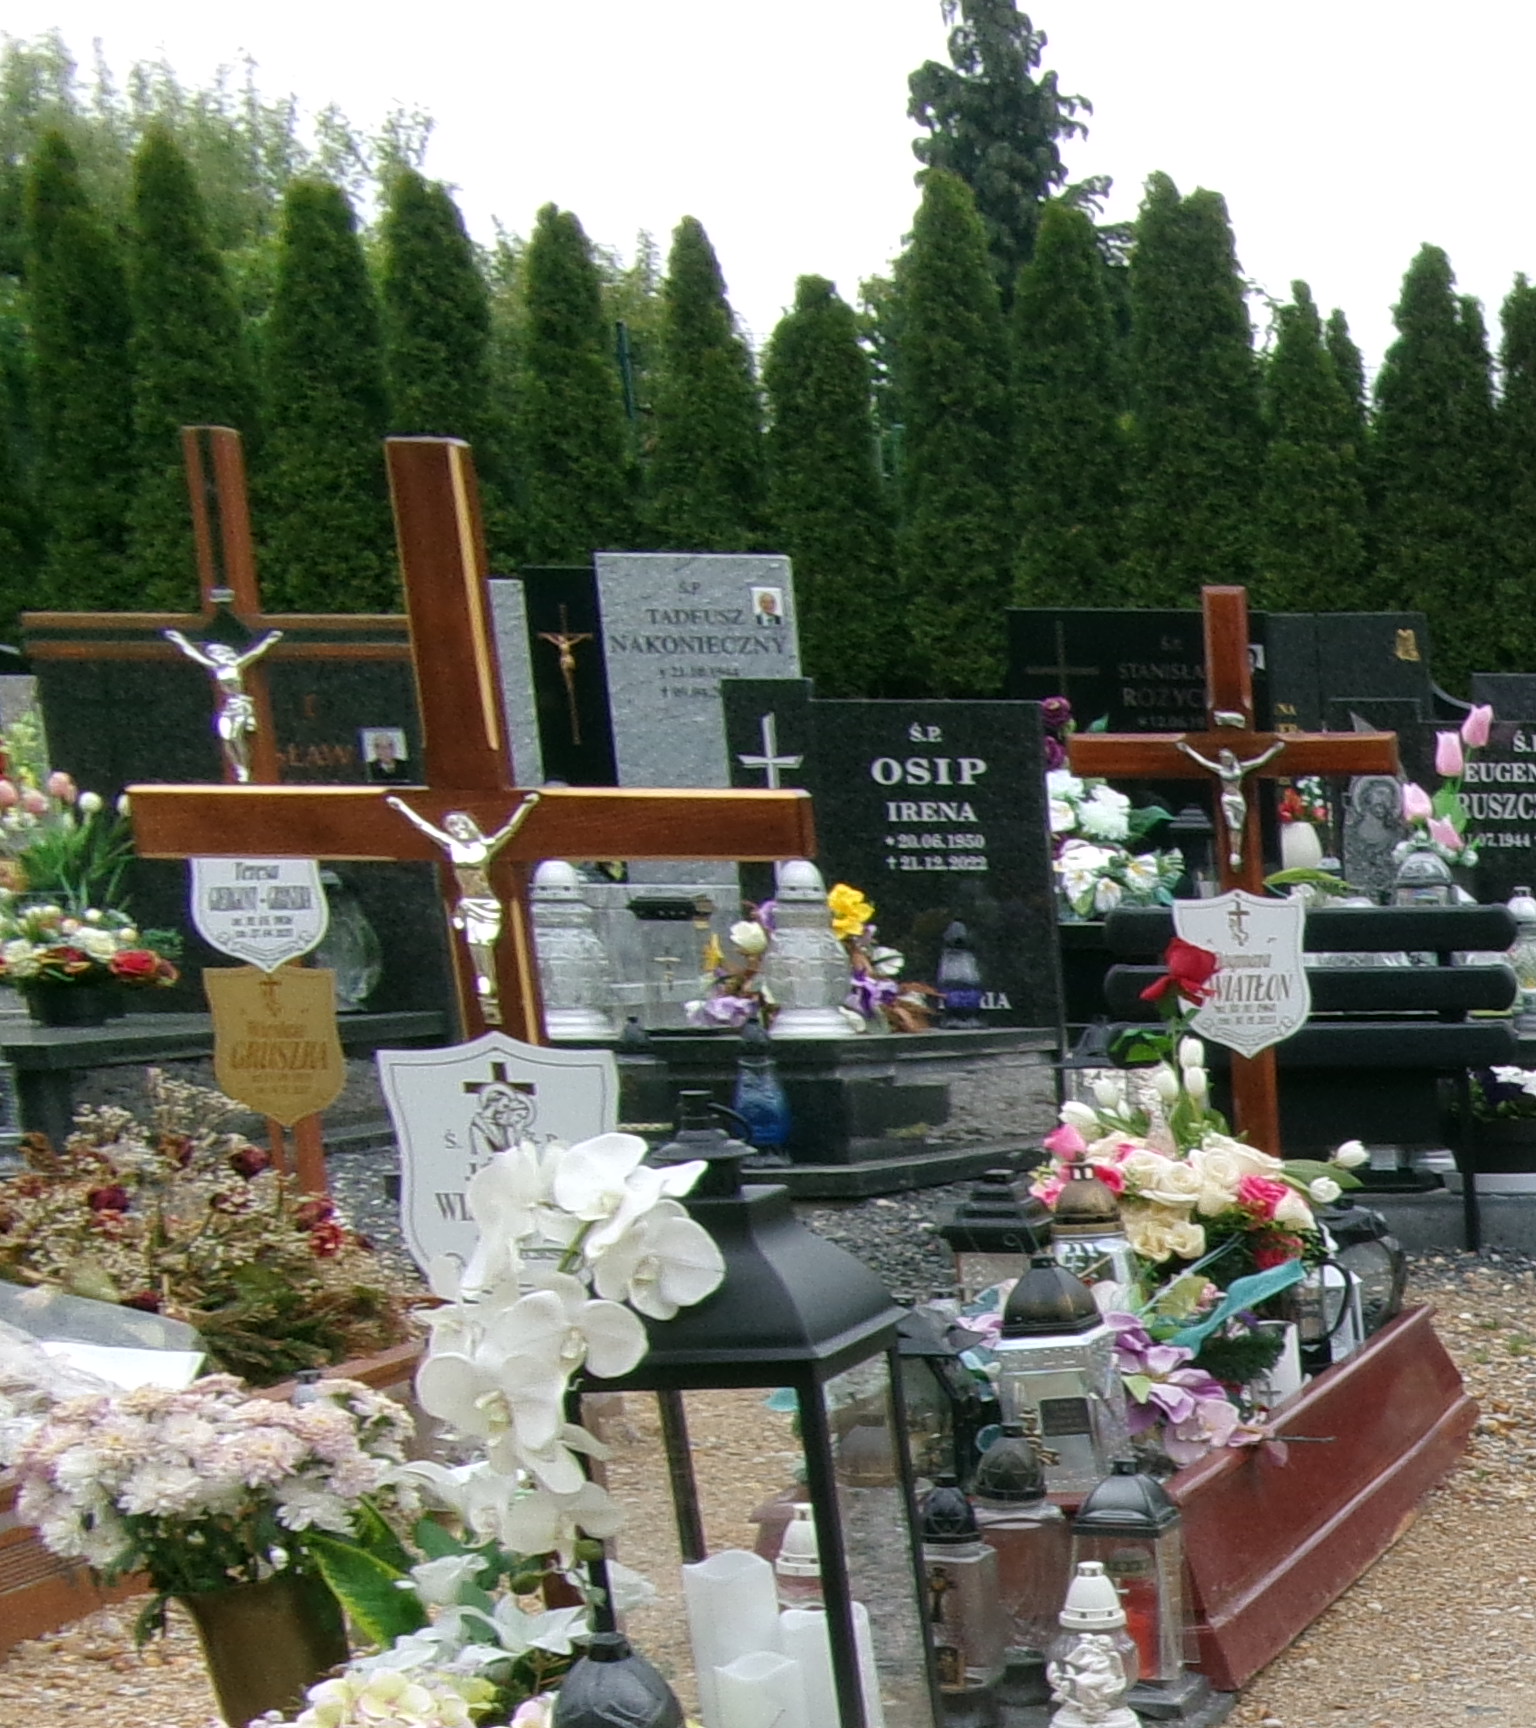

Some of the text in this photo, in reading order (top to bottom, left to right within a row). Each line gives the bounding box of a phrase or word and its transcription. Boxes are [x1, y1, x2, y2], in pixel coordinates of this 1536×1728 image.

[646, 608, 746, 626] TADEUSZ
[610, 634, 787, 656] NAKONIECZNY
[870, 756, 988, 786] OSIP
[886, 801, 979, 822] IRENA
